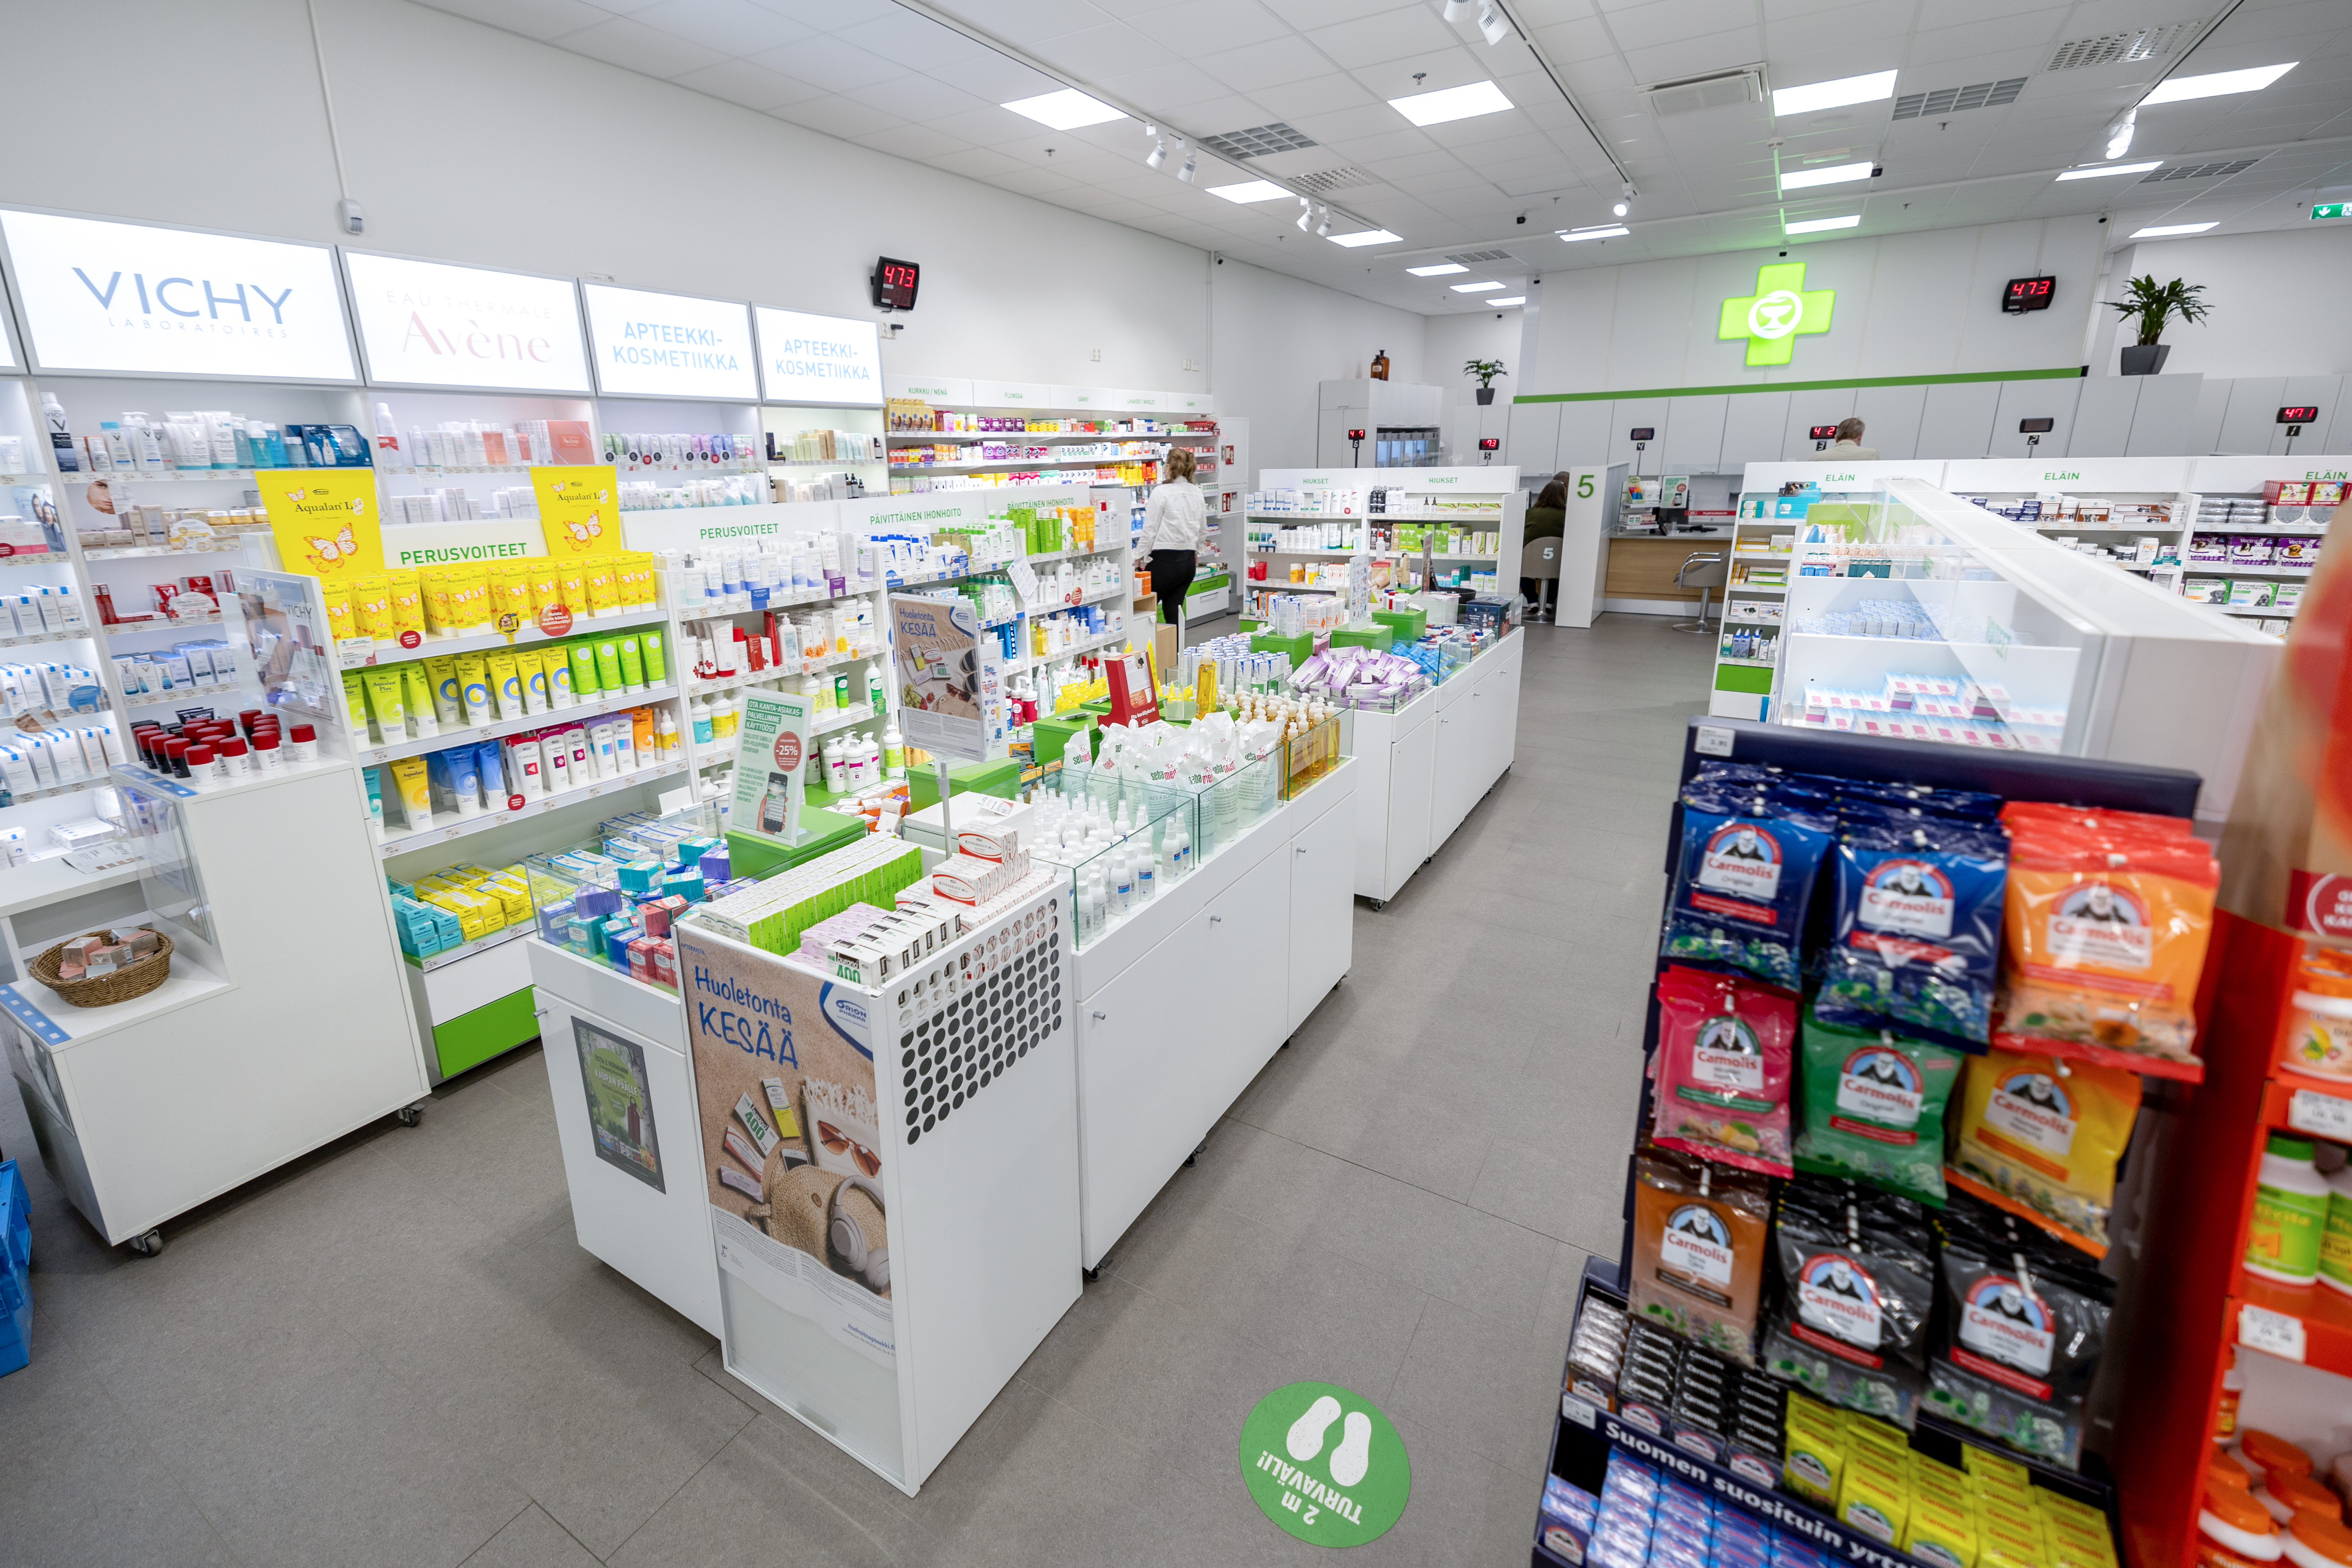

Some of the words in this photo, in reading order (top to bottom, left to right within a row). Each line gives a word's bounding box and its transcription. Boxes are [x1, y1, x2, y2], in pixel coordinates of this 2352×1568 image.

[71, 267, 293, 324] VICHY
[387, 290, 431, 307] EAU
[445, 297, 552, 319] THERMALE
[109, 318, 288, 338] LABORATOIRES
[403, 311, 552, 362] Avène
[624, 322, 723, 347] APTEEKKI-
[613, 345, 739, 371] KOSMETIIKKA
[784, 339, 858, 359] APTEEKKI-
[776, 359, 869, 380] KOSMETIIKKA
[1818, 441, 1825, 450] 3
[2029, 436, 2038, 445] 2
[1825, 472, 1856, 482] ELÄIN
[2044, 470, 2080, 480] ELÄIN
[2305, 470, 2348, 480] ELÄIN
[1577, 475, 1594, 498] 5
[557, 493, 591, 502] Aqualan
[1007, 500, 1045, 509] PÄIVITTÄINEN
[1047, 497, 1074, 507] IHONHOITO
[295, 502, 342, 514] Aqualan
[870, 511, 922, 525] PÄIVITTÄINEN
[924, 508, 961, 519] IHONHOITO
[699, 523, 779, 539] PERUSVOITEET
[400, 542, 527, 565] PERUSVOITEET
[1543, 547, 1554, 559] 5
[285, 603, 312, 620] VICHY
[899, 608, 934, 623] Huoletonta
[900, 621, 936, 638] KESÄÄ
[747, 711, 781, 723] PALVELUMME
[759, 702, 802, 716] KANTA-ASIAKAS-
[746, 720, 775, 733] KÄYTTÖÖSI!
[776, 745, 798, 756] -25%
[965, 840, 988, 849] KYYPAKKAUS
[1707, 857, 1773, 879] Carmolis
[939, 881, 961, 891] KYYPAKKAUS
[681, 943, 706, 956] APTEEKISTA.
[837, 952, 858, 969] burana
[695, 966, 792, 1026] Huoletonta
[836, 1000, 867, 1018] ORION
[839, 1009, 866, 1023] PHARMA
[699, 1001, 799, 1070] KESÄÄ
[1697, 1050, 1757, 1071] Carmolis
[594, 1068, 617, 1086] KAUPAN
[617, 1078, 638, 1097] PÄÄLLE
[1845, 1078, 1914, 1108] Carmolis
[745, 1111, 765, 1141] 400
[751, 1104, 769, 1131] burana
[1667, 1233, 1727, 1264] Carmolis
[1804, 1289, 1875, 1323] Carmolis
[848, 1322, 895, 1351] itsehoitoapteekki.fi
[1969, 1310, 2046, 1349] Carmolis
[1256, 1450, 1362, 1525] TURVAVÄLI!
[1605, 1420, 1708, 1483] Suomen
[1713, 1474, 1842, 1549] suosituin
[1281, 1491, 1302, 1513] m
[1303, 1505, 1320, 1525] 2
